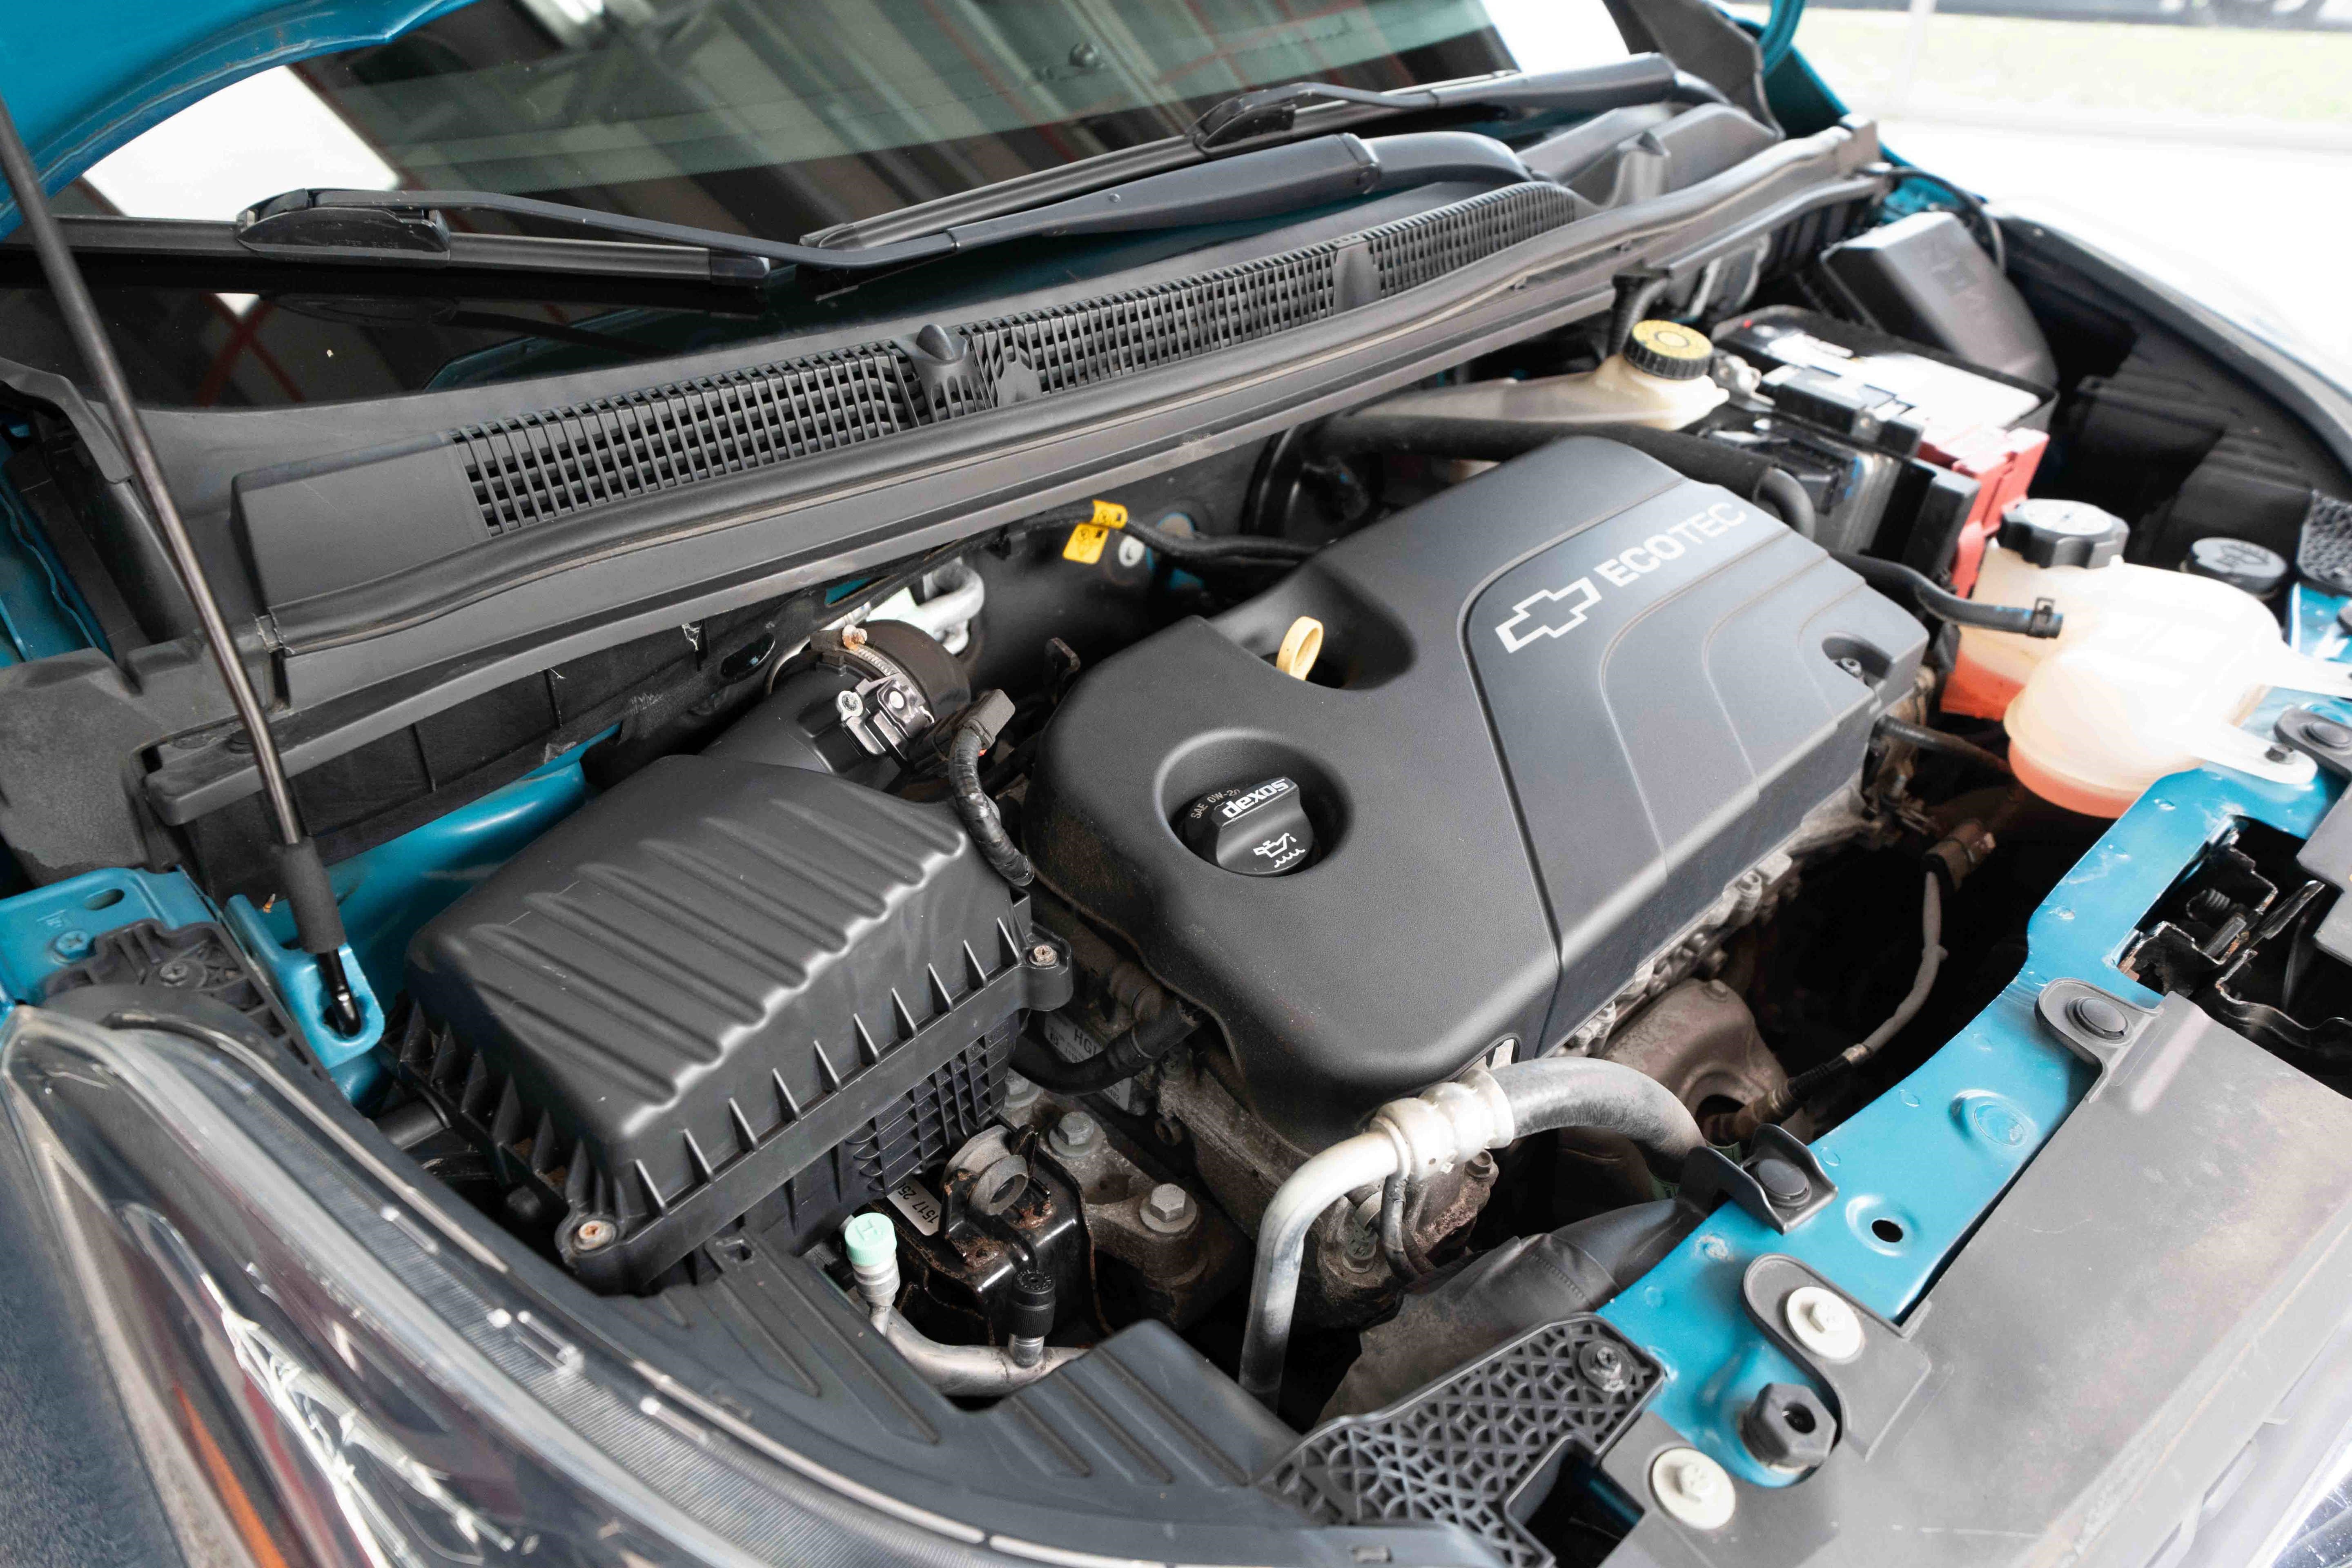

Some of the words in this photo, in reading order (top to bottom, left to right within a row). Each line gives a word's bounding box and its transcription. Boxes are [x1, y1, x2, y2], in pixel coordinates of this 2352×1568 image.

[1594, 502, 1747, 588] ECOTEC
[1190, 803, 1208, 818] SAE
[1222, 778, 1289, 818] dexos
[912, 1201, 939, 1224] 1517
